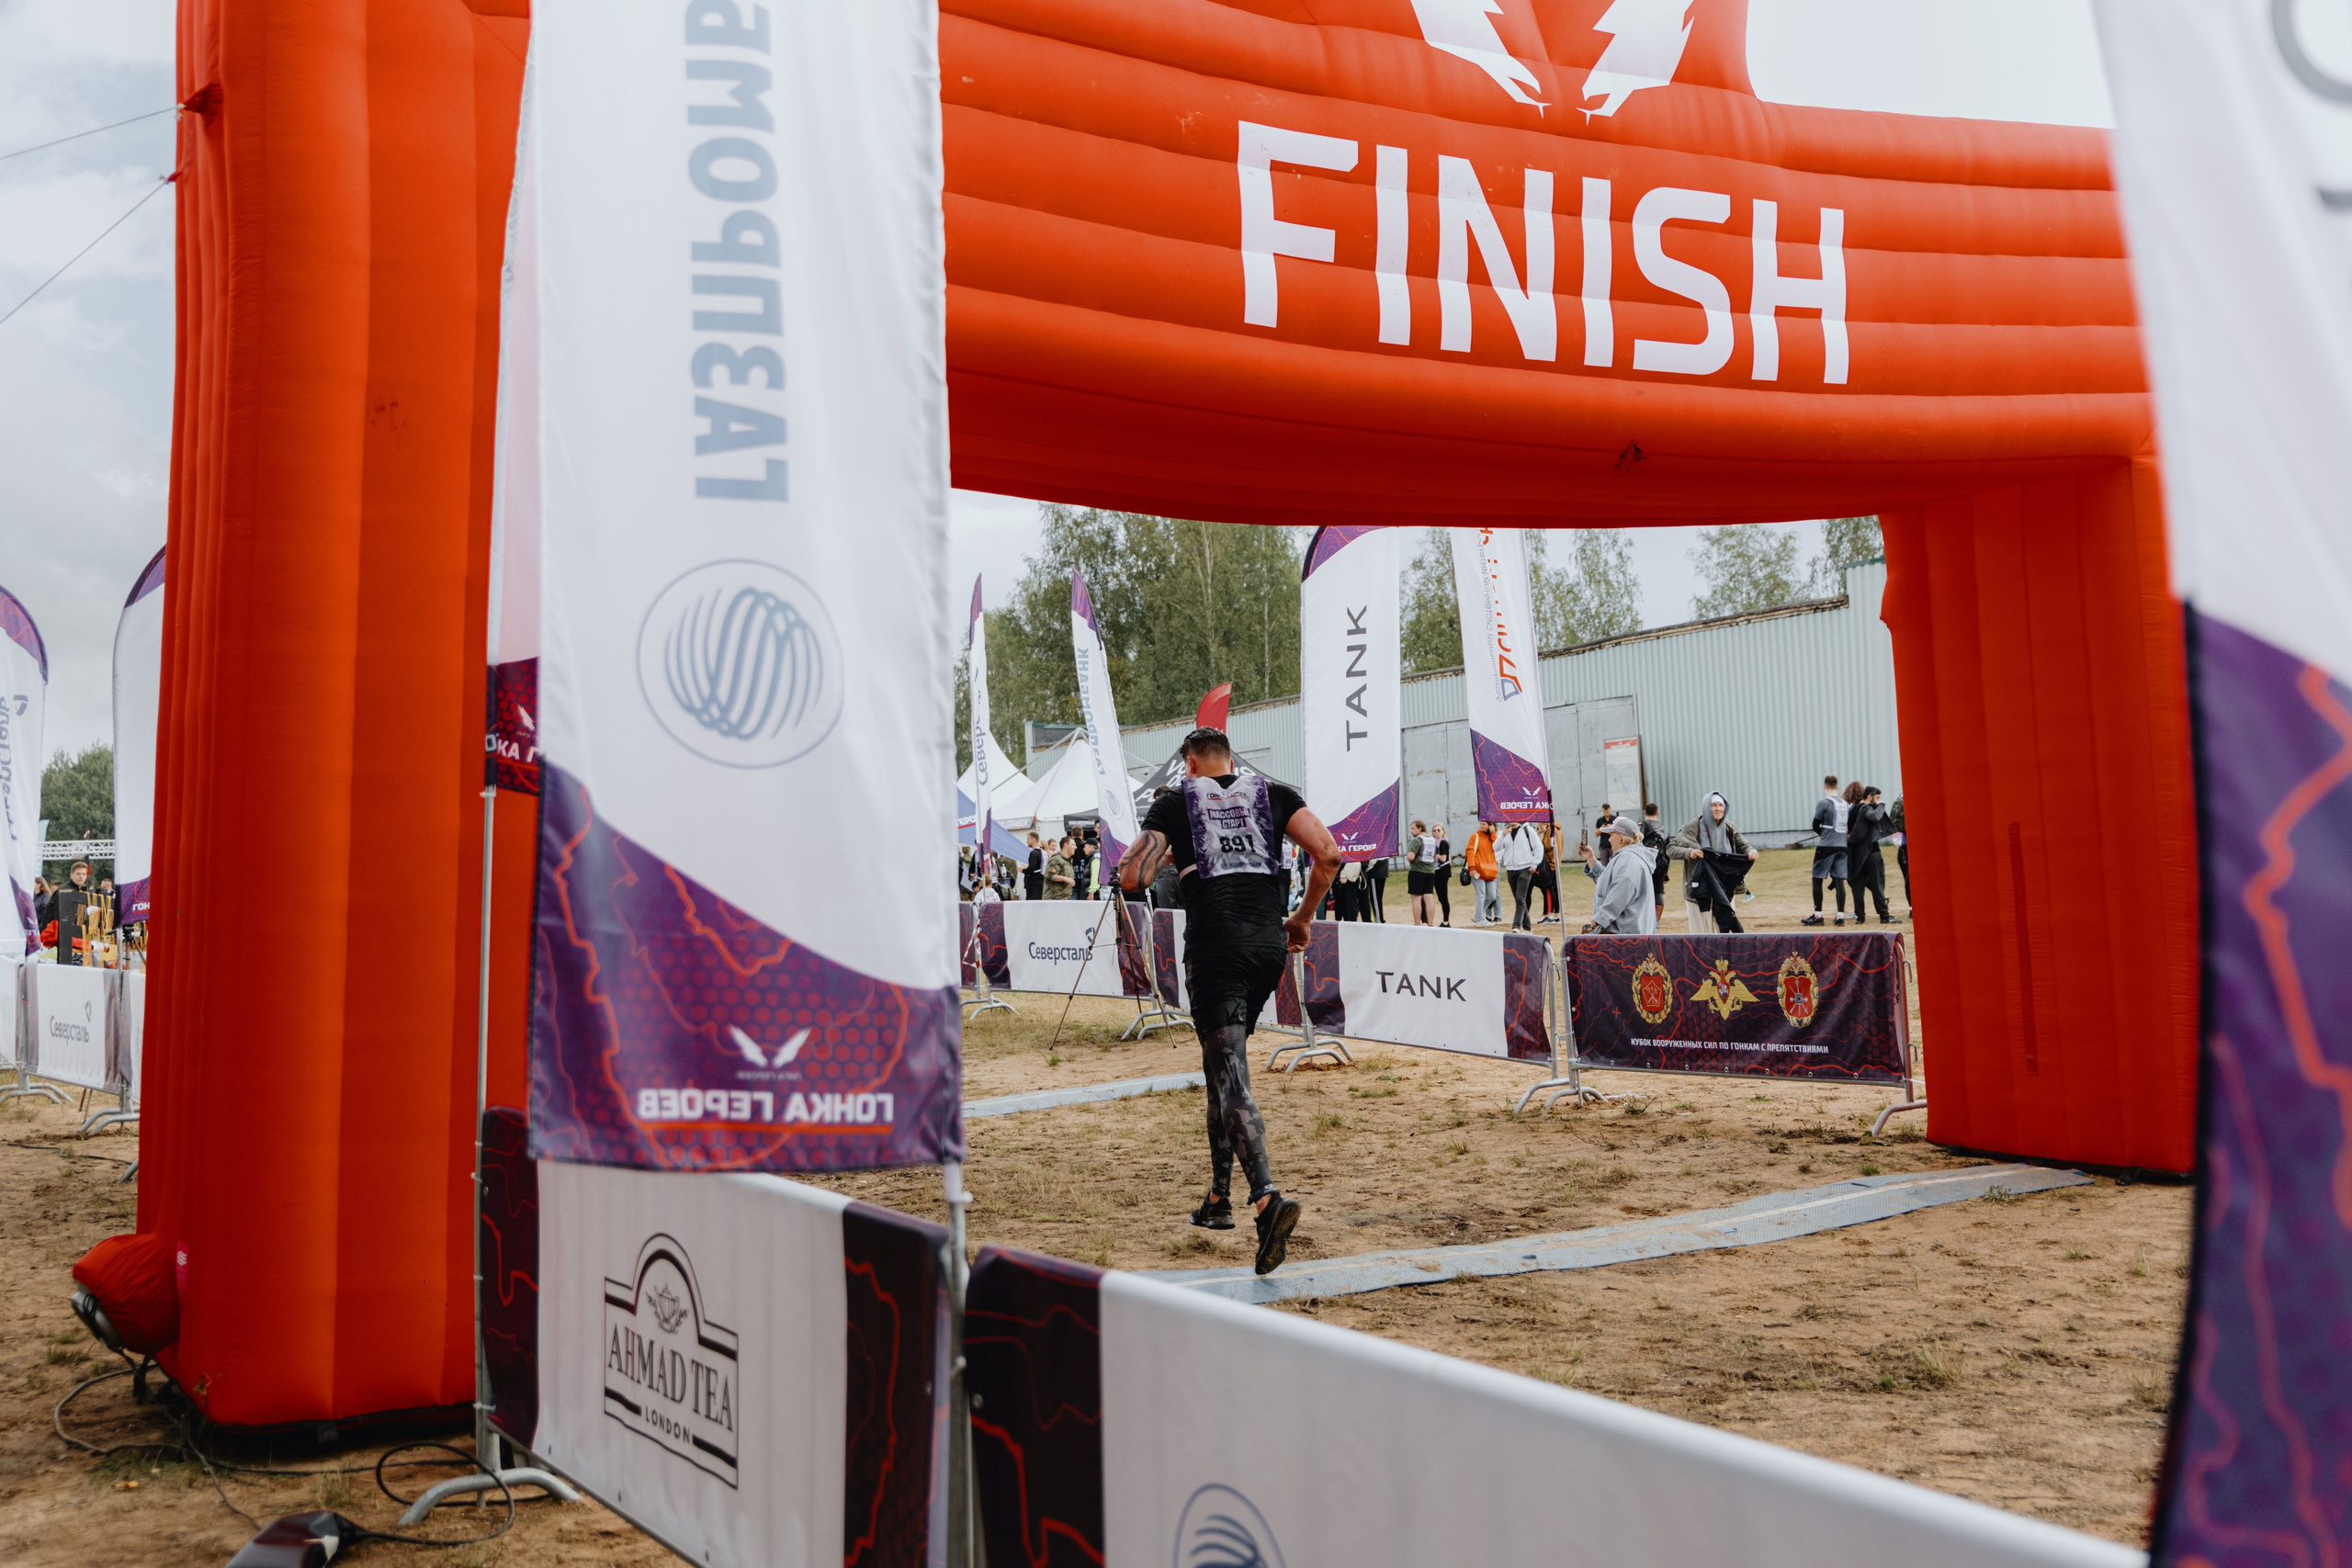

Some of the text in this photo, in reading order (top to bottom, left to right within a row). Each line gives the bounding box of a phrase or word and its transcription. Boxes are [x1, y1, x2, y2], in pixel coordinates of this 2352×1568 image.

[1238, 119, 1849, 386] FINISH
[1346, 604, 1368, 752] TANK
[1222, 818, 1245, 828] СТАРТ
[1219, 834, 1256, 853] 891
[1348, 843, 1376, 852] ГЕРОЕВ
[1028, 942, 1093, 965] Северсталь
[1375, 971, 1466, 1001] TANK
[50, 1015, 90, 1046] Северсталь
[1631, 1038, 1652, 1046] КУБОК
[1653, 1039, 1702, 1049] ВООРУЖЕННЫХ
[1703, 1041, 1717, 1049] СИЛ
[1719, 1042, 1729, 1050] ПО
[1731, 1043, 1759, 1051] ГОНКАМ
[1767, 1043, 1829, 1054] ПРЕПЯТСТВИЯМИ
[608, 1323, 733, 1432] AHMAD TEA
[645, 1406, 690, 1444] LONDON
